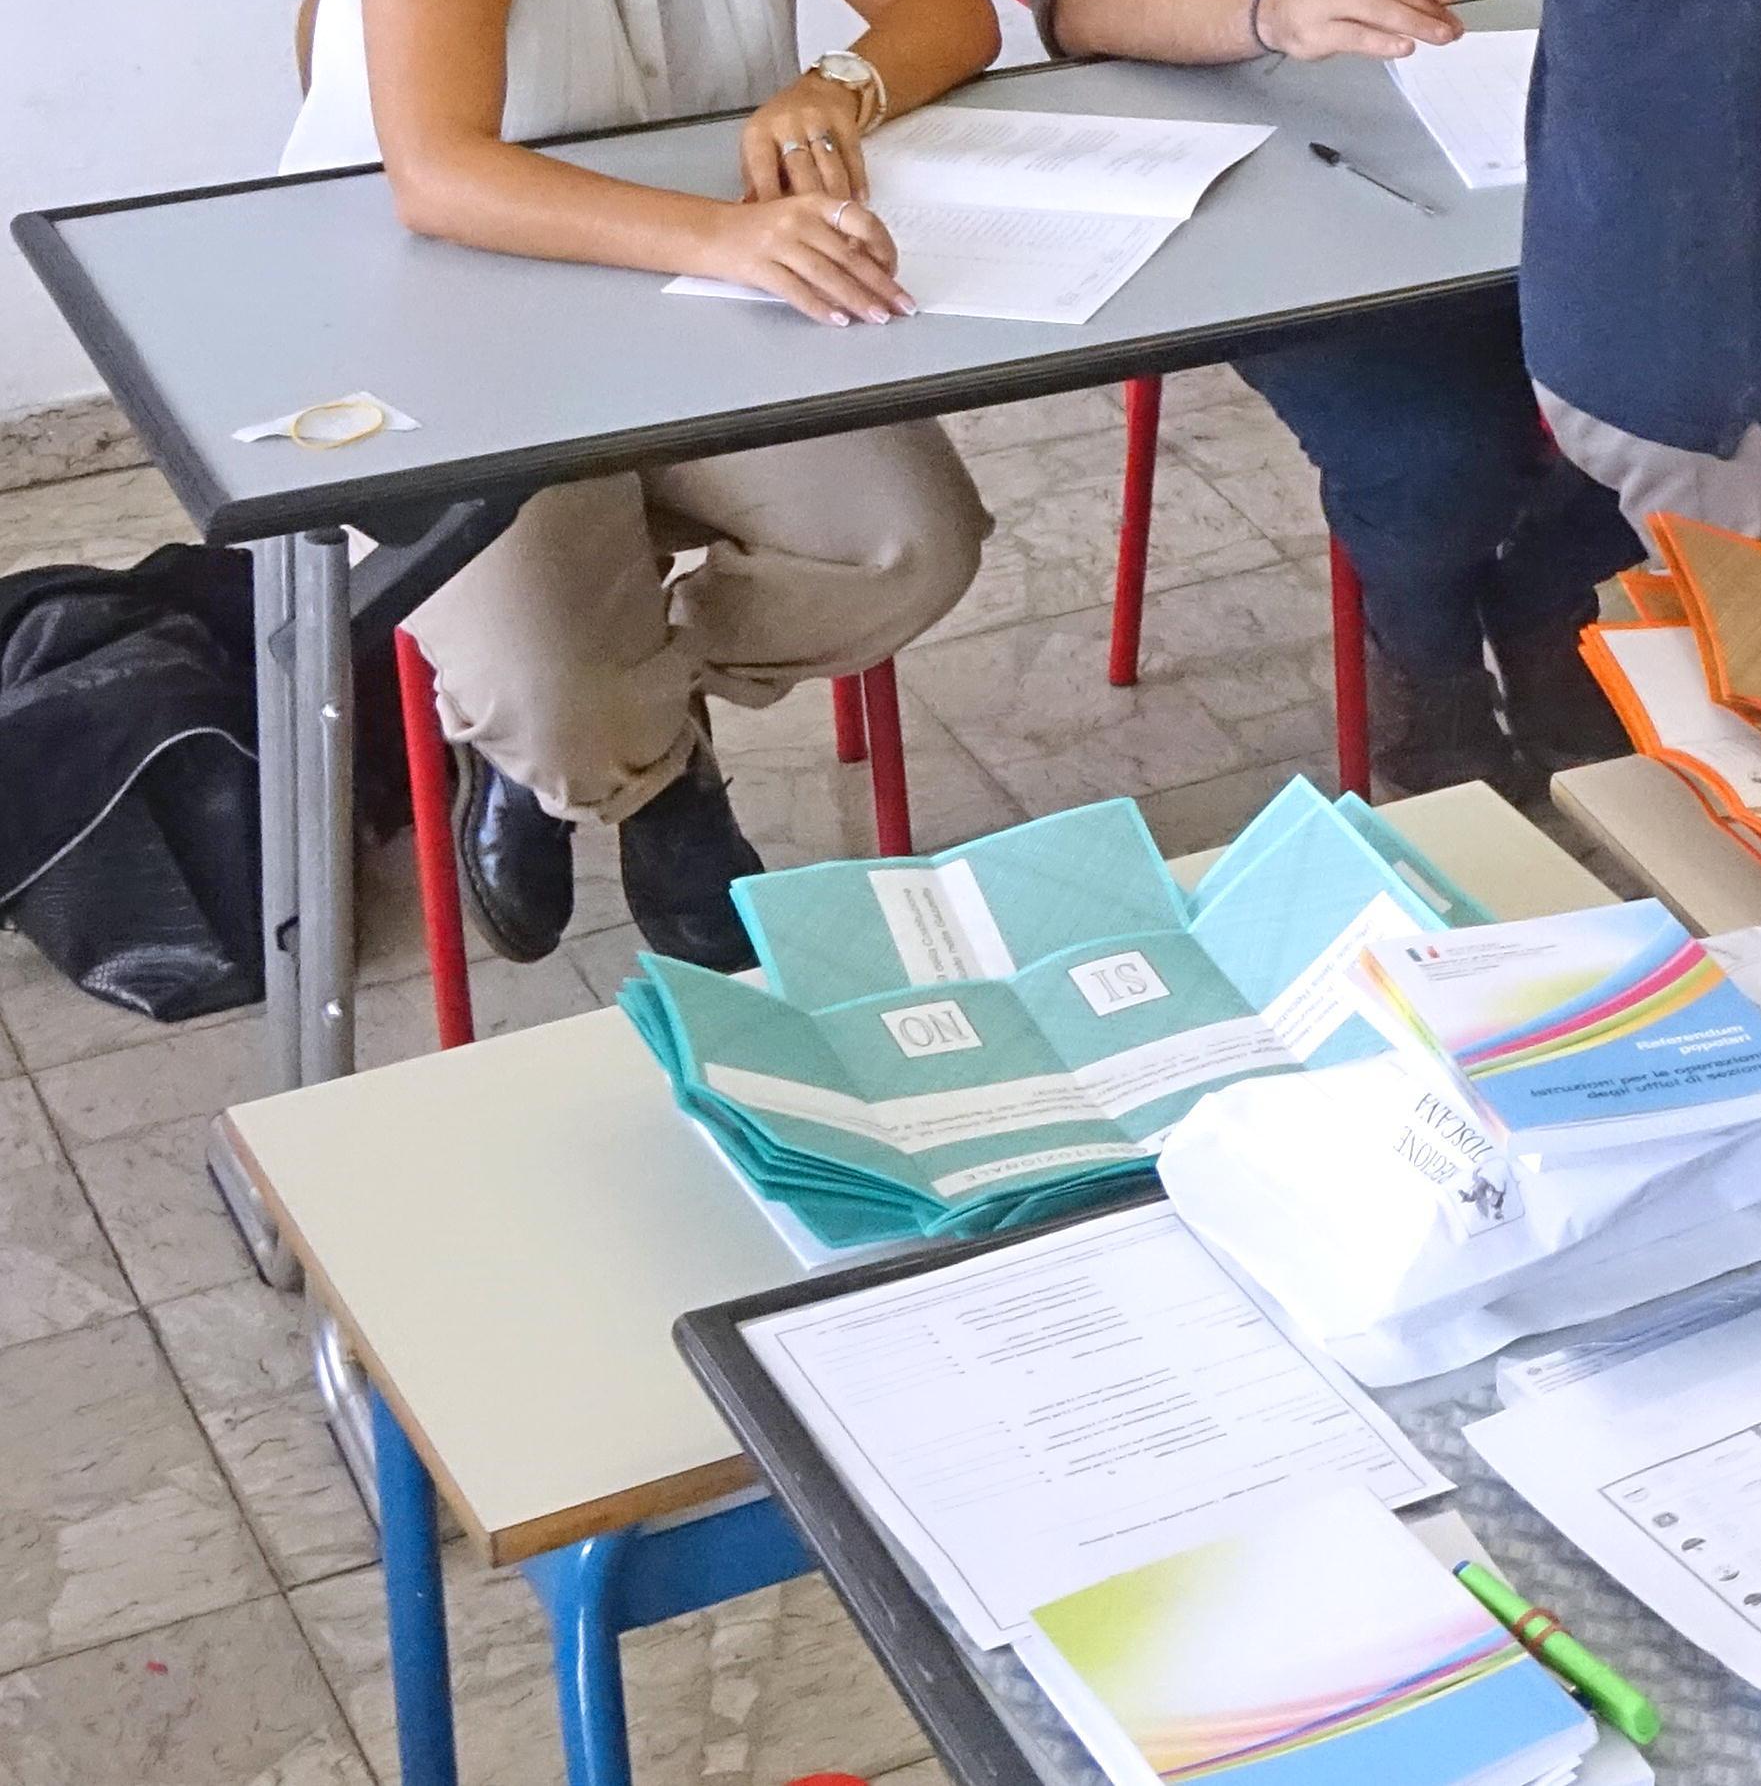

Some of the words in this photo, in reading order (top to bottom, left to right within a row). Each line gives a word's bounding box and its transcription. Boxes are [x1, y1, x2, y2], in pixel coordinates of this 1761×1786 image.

[1636, 1024, 1745, 1051] Referendum
[1679, 1033, 1752, 1056] popolari
[1620, 1073, 1649, 1087] per
